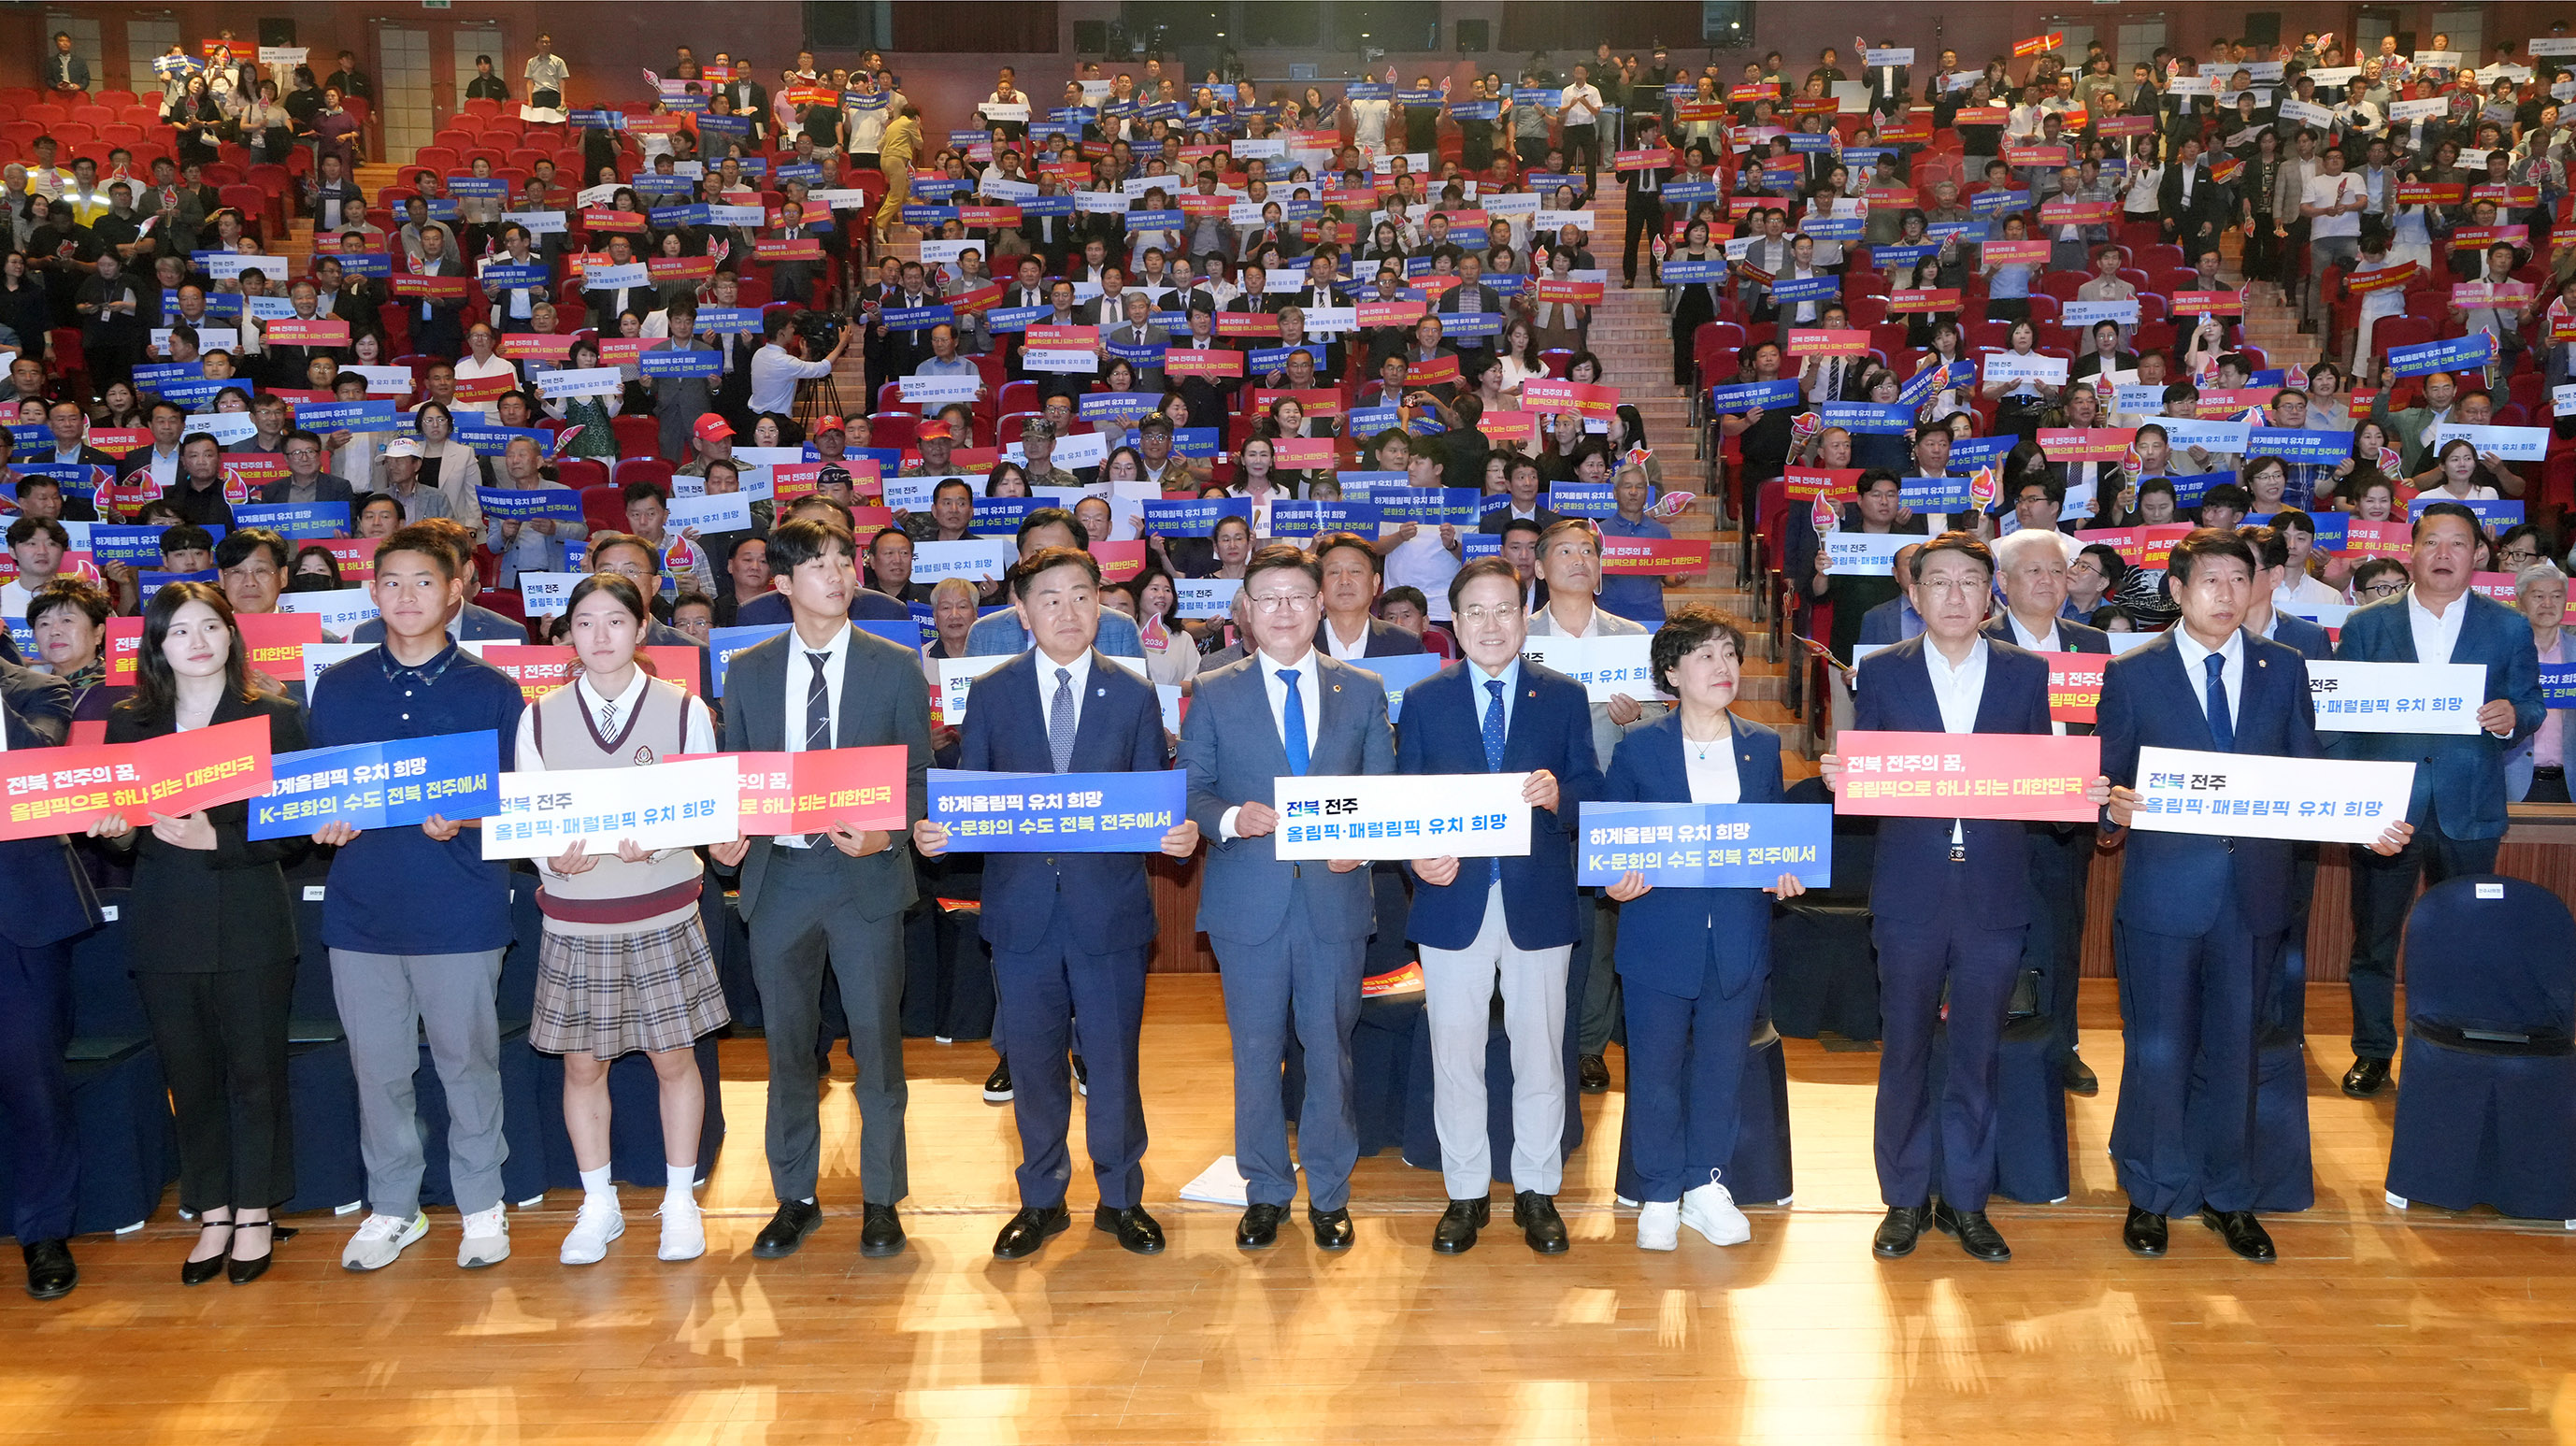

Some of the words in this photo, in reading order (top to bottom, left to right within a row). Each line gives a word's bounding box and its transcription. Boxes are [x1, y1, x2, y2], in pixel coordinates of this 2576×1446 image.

[2392, 351, 2425, 363] 하계올림픽
[2426, 348, 2440, 357] 유치
[2393, 362, 2422, 372] K-문화의
[2425, 359, 2438, 367] 수도
[2456, 350, 2486, 361] 전주에서
[1526, 397, 1558, 406] 올림픽으로
[1717, 392, 1744, 400] 하계올림픽
[1718, 399, 1741, 408] K-문화의
[1770, 392, 1794, 402] 전주에서
[300, 421, 329, 429] K-문화의
[2253, 436, 2288, 444] 하계올림픽
[1974, 485, 1989, 494] 2036
[481, 495, 513, 506] 하계올림픽
[483, 505, 508, 514] K-문화의
[703, 514, 719, 523] 유치
[723, 509, 739, 521] 희망
[1184, 508, 1200, 517] 유치
[1202, 508, 1218, 516] 희망
[1149, 522, 1179, 530] K-문화의
[1181, 521, 1196, 529] 수도
[1276, 523, 1309, 531] K-문화의
[1310, 523, 1325, 531] 수도
[1344, 523, 1373, 531] 전주에서
[95, 537, 138, 545] 하계올림픽
[141, 536, 159, 544] 유치
[1831, 544, 1848, 552] 전북
[97, 549, 134, 558] K-문화의
[136, 547, 156, 556] 수도
[670, 555, 689, 566] 2036
[1672, 556, 1701, 565] 대한민국
[975, 559, 992, 568] 희망
[1178, 590, 1194, 598] 전북
[1145, 638, 1163, 647] 2036
[2308, 677, 2338, 693] 전주
[2539, 674, 2559, 684] 유치
[2396, 698, 2428, 712] 유치
[2431, 695, 2463, 712] 희망
[352, 765, 390, 782] 유치
[394, 757, 427, 779] 희망
[1846, 754, 1882, 773] 전북
[1886, 754, 1938, 772] 전주의
[1943, 754, 1966, 772] 꿈,
[7, 774, 49, 795] 전북
[52, 766, 111, 790] 전주의
[116, 765, 140, 782] 꿈,
[768, 772, 791, 789] 꿈,
[1845, 780, 1931, 799] 올림픽으로
[1937, 780, 1970, 796] 하나
[1975, 780, 2008, 796] 되는
[2012, 777, 2082, 795] 대한민국
[2149, 771, 2184, 790] 전북
[2190, 774, 2226, 791] 전주
[9, 794, 110, 823] 올림픽으로
[113, 789, 149, 809] 하나
[151, 779, 183, 799] 되는
[185, 755, 254, 789] 대한민국
[259, 798, 337, 824] K-문화의
[343, 790, 382, 810] 수도
[387, 785, 422, 806] 전북
[426, 773, 487, 799] 전주에서
[498, 796, 530, 814] 전북
[537, 793, 572, 810] 전주
[762, 796, 795, 815] 하나
[797, 794, 826, 812] 되는
[829, 785, 891, 808] 대한민국
[937, 794, 1023, 813] 하계올림픽
[1028, 794, 1062, 809] 유치
[1067, 791, 1102, 809] 희망
[2145, 796, 2290, 817] 올림픽·패럴림픽
[2297, 800, 2336, 817] 유치
[2344, 800, 2383, 817] 희망
[1286, 800, 1319, 817] 전북
[1324, 797, 1358, 815] 전주
[495, 812, 636, 841] 올림픽·패럴림픽
[643, 806, 676, 827] 유치
[682, 798, 715, 819] 희망
[941, 819, 1012, 838] K-문화의
[1019, 818, 1052, 835] 수도
[1059, 816, 1095, 833] 전북
[1100, 810, 1171, 830] 전주에서
[1286, 820, 1420, 842] 올림픽·패럴림픽
[1428, 817, 1464, 836] 유치
[1470, 813, 1507, 831] 희망
[1589, 826, 1673, 845] 하계올림픽
[1677, 824, 1710, 841] 유치
[1715, 822, 1750, 839] 희망
[1589, 852, 1662, 871] K-문화의
[1667, 850, 1702, 868] 수도
[1708, 849, 1741, 866] 전북
[1747, 845, 1816, 865] 전주에서
